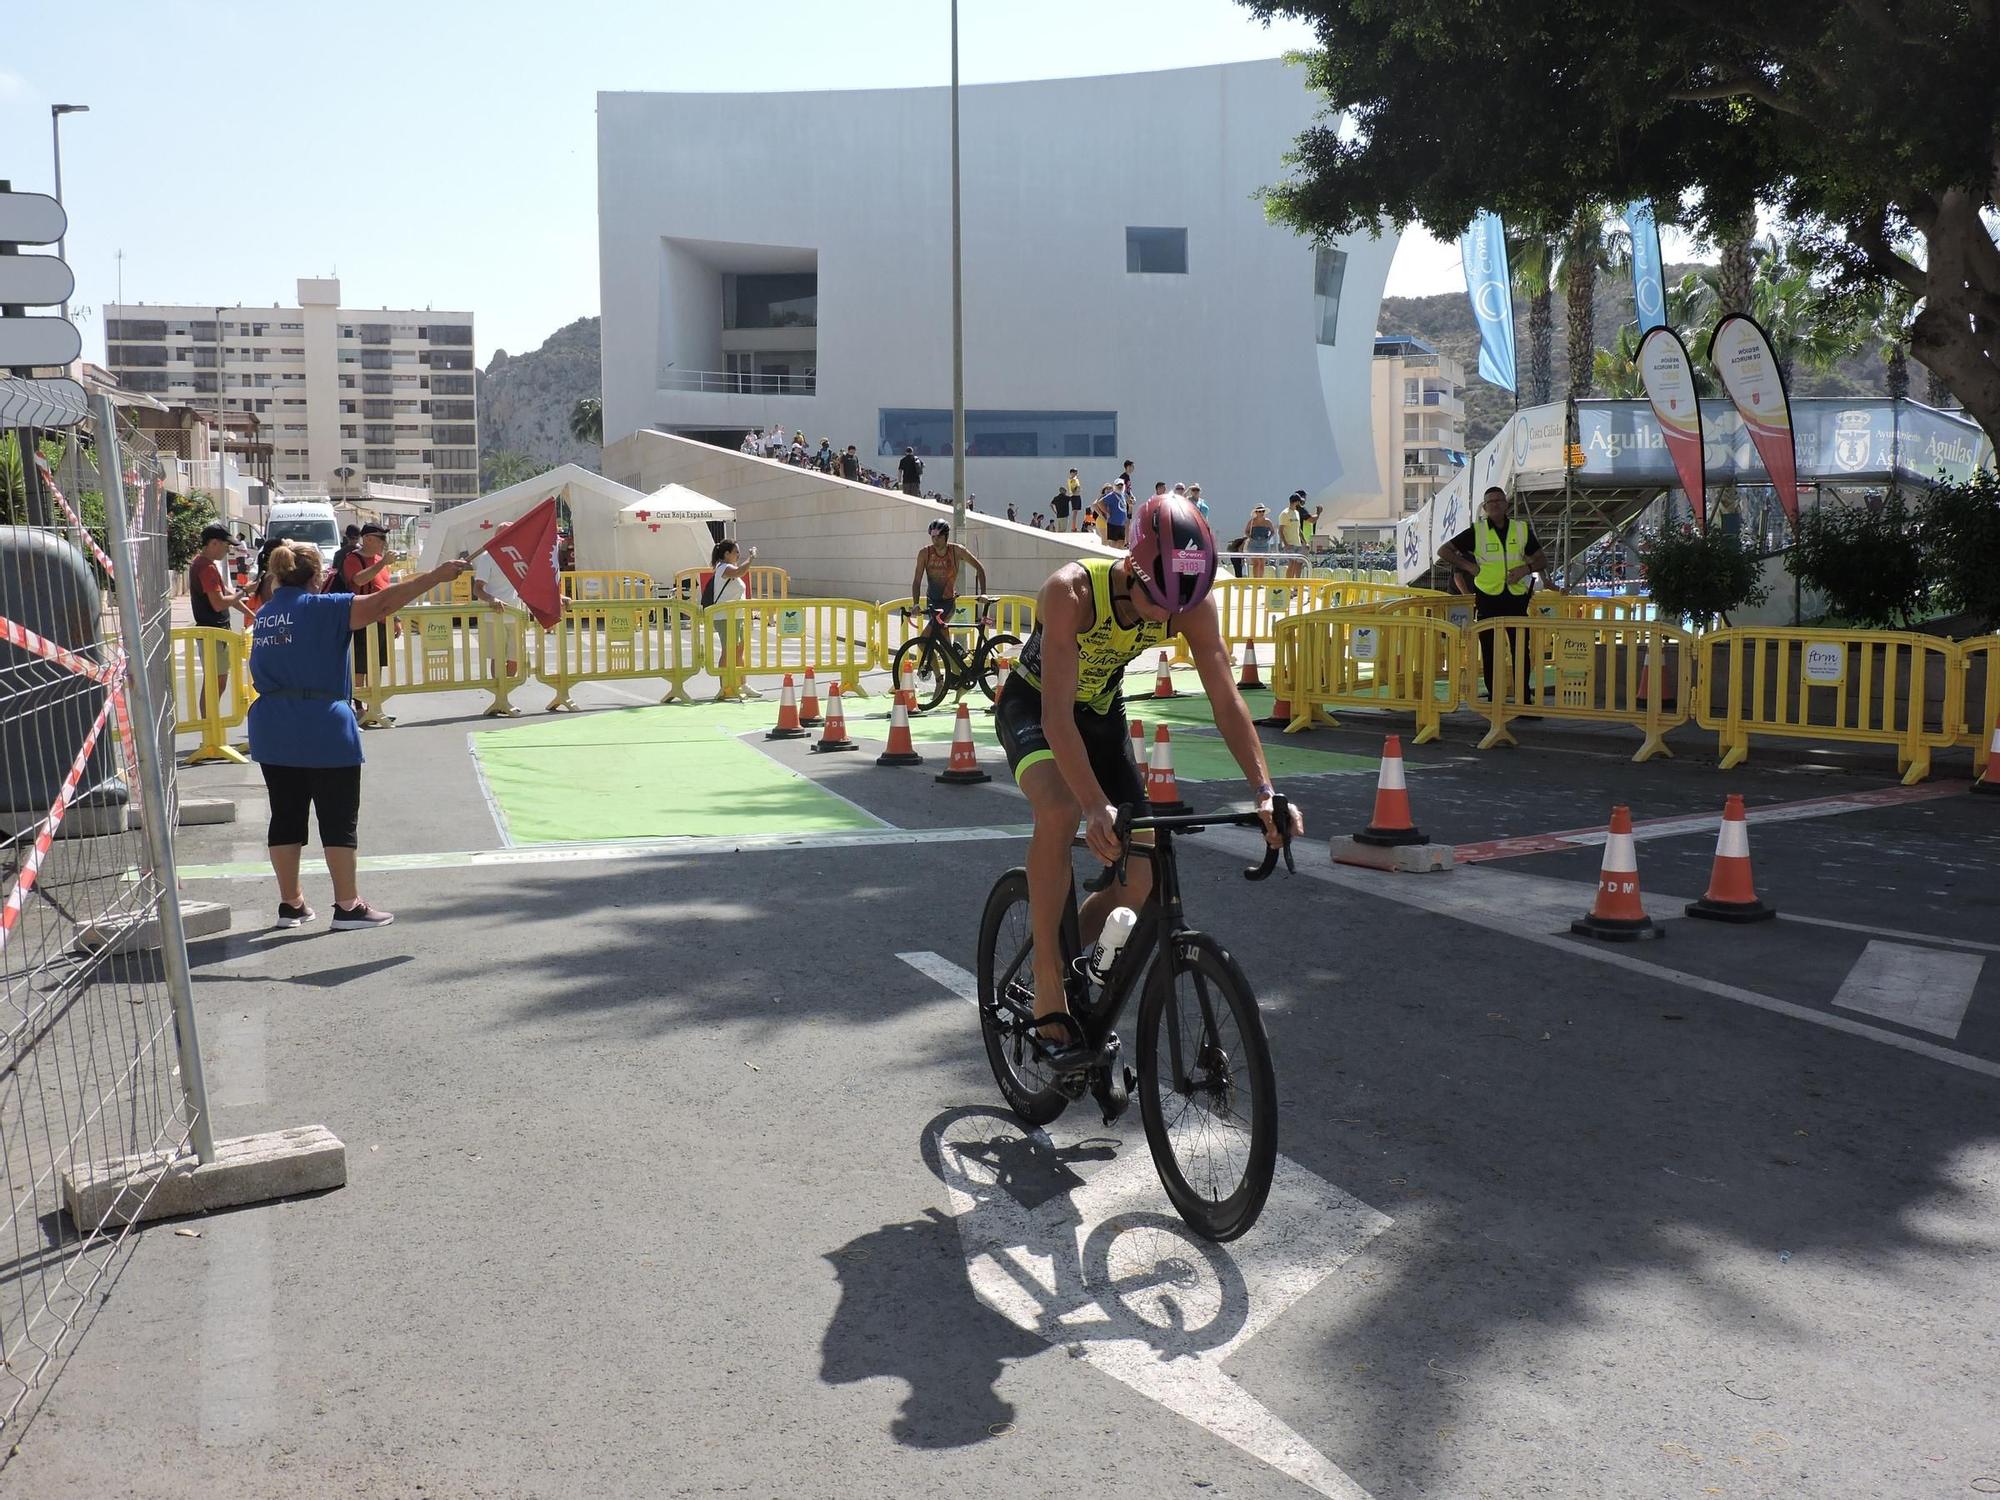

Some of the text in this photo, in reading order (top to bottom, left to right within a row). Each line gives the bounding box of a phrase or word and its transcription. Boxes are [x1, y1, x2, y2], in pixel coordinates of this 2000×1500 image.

[1589, 425, 1668, 458] Águila
[1925, 431, 1973, 466] Águilas
[656, 511, 713, 519] Cruz Roja Española
[1179, 562, 1199, 573] 3103
[1808, 649, 1839, 664] ftrm
